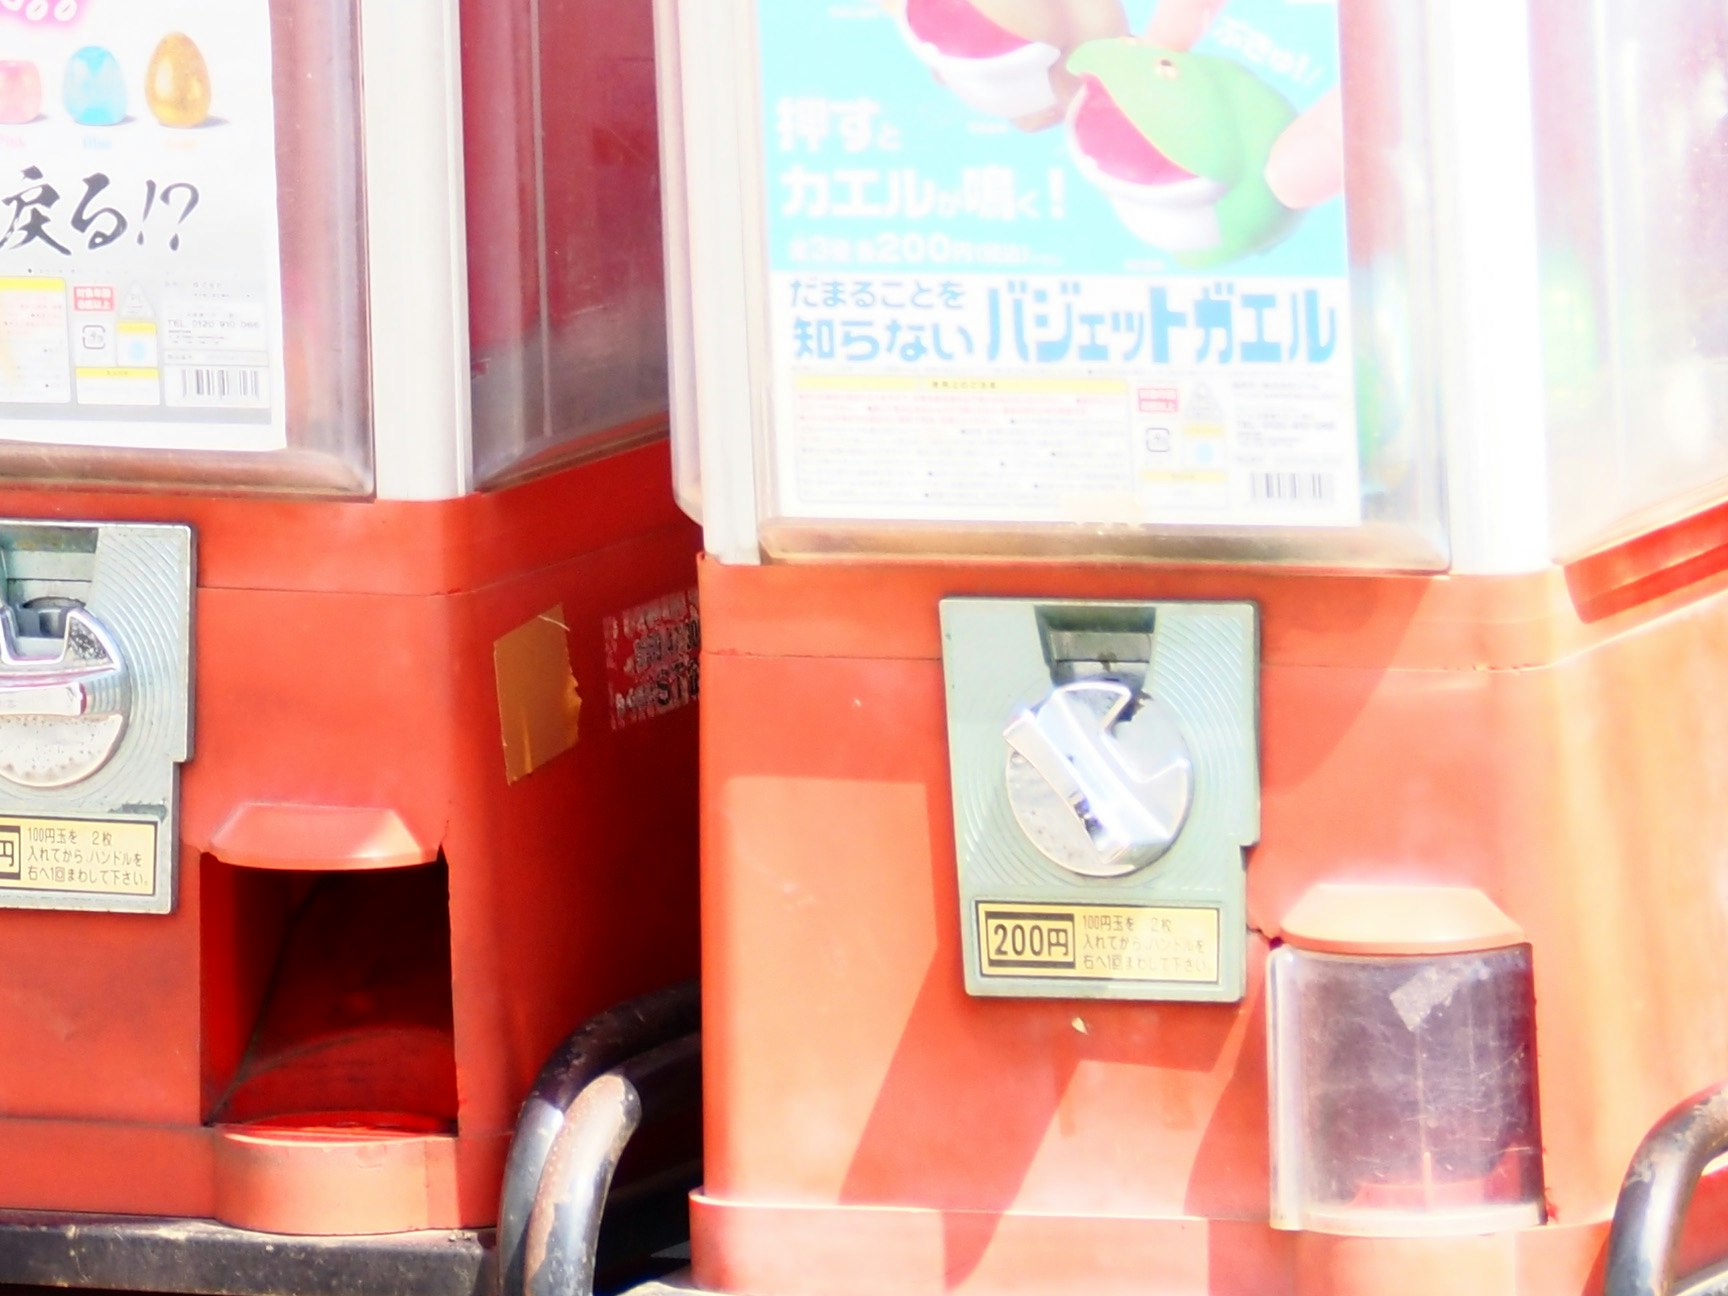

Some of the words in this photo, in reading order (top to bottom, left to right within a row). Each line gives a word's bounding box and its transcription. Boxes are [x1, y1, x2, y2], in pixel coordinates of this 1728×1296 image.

[776, 95, 901, 153] 押すと
[789, 278, 966, 310] だまることを
[986, 279, 1338, 365] バジェットガエル
[792, 316, 974, 363] 知らない
[28, 826, 78, 845] 100円玉を
[91, 830, 113, 847] 2枚
[27, 846, 84, 862] 入れてから
[87, 851, 143, 867] ハンドルを
[1081, 914, 1135, 932] 100円玉を
[992, 923, 1069, 958] 200円
